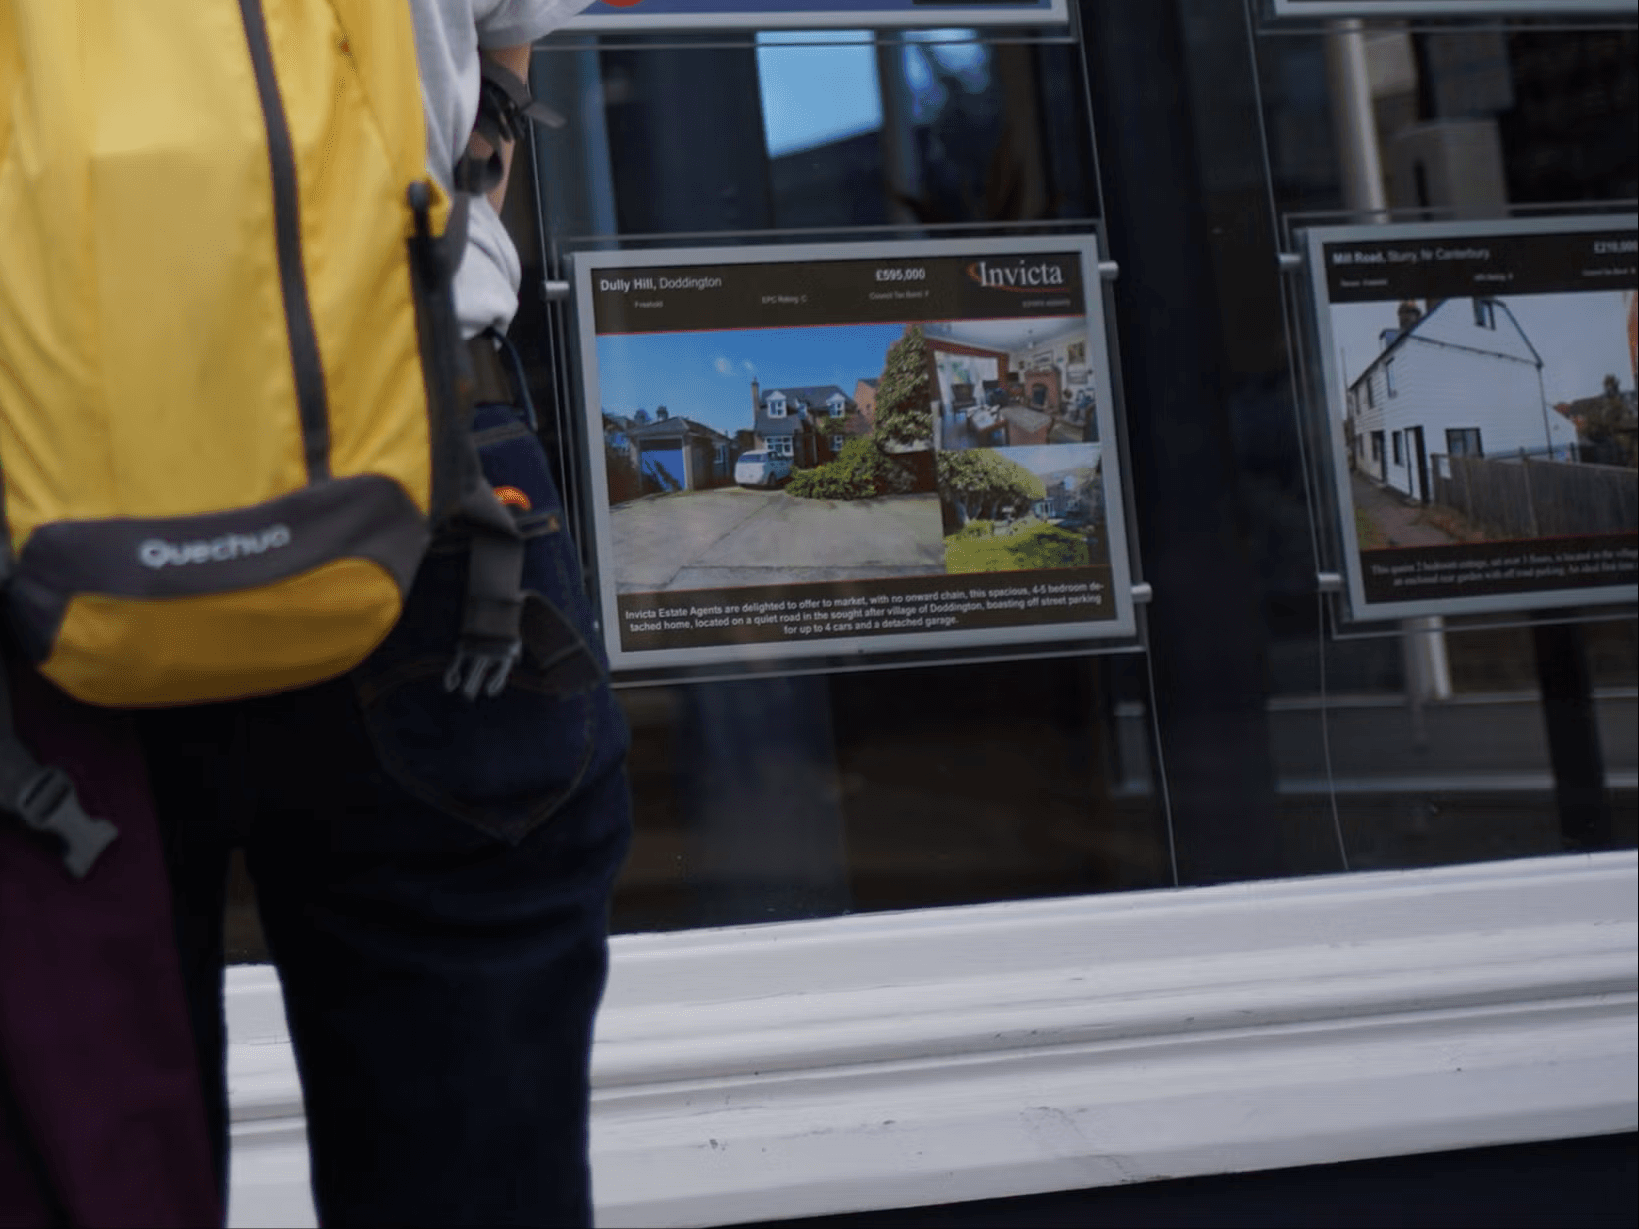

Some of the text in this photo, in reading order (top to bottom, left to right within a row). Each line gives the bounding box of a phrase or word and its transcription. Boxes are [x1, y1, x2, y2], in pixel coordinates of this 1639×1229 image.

[600, 276, 722, 292] Dully Hill, Doddington
[875, 268, 926, 281] £595,000
[979, 259, 1065, 287] Invicta
[138, 523, 292, 570] Quechua
[625, 609, 656, 619] Invicta
[658, 607, 688, 617] Estate
[689, 605, 723, 617] Agents
[724, 605, 740, 613] are
[741, 600, 785, 613] delighted
[786, 601, 797, 609] to
[798, 599, 820, 609] offer
[821, 599, 832, 607] to
[869, 595, 889, 604] with
[891, 595, 903, 603] no
[904, 591, 939, 602] onward
[968, 589, 986, 598] this
[1047, 583, 1087, 593] bedroom
